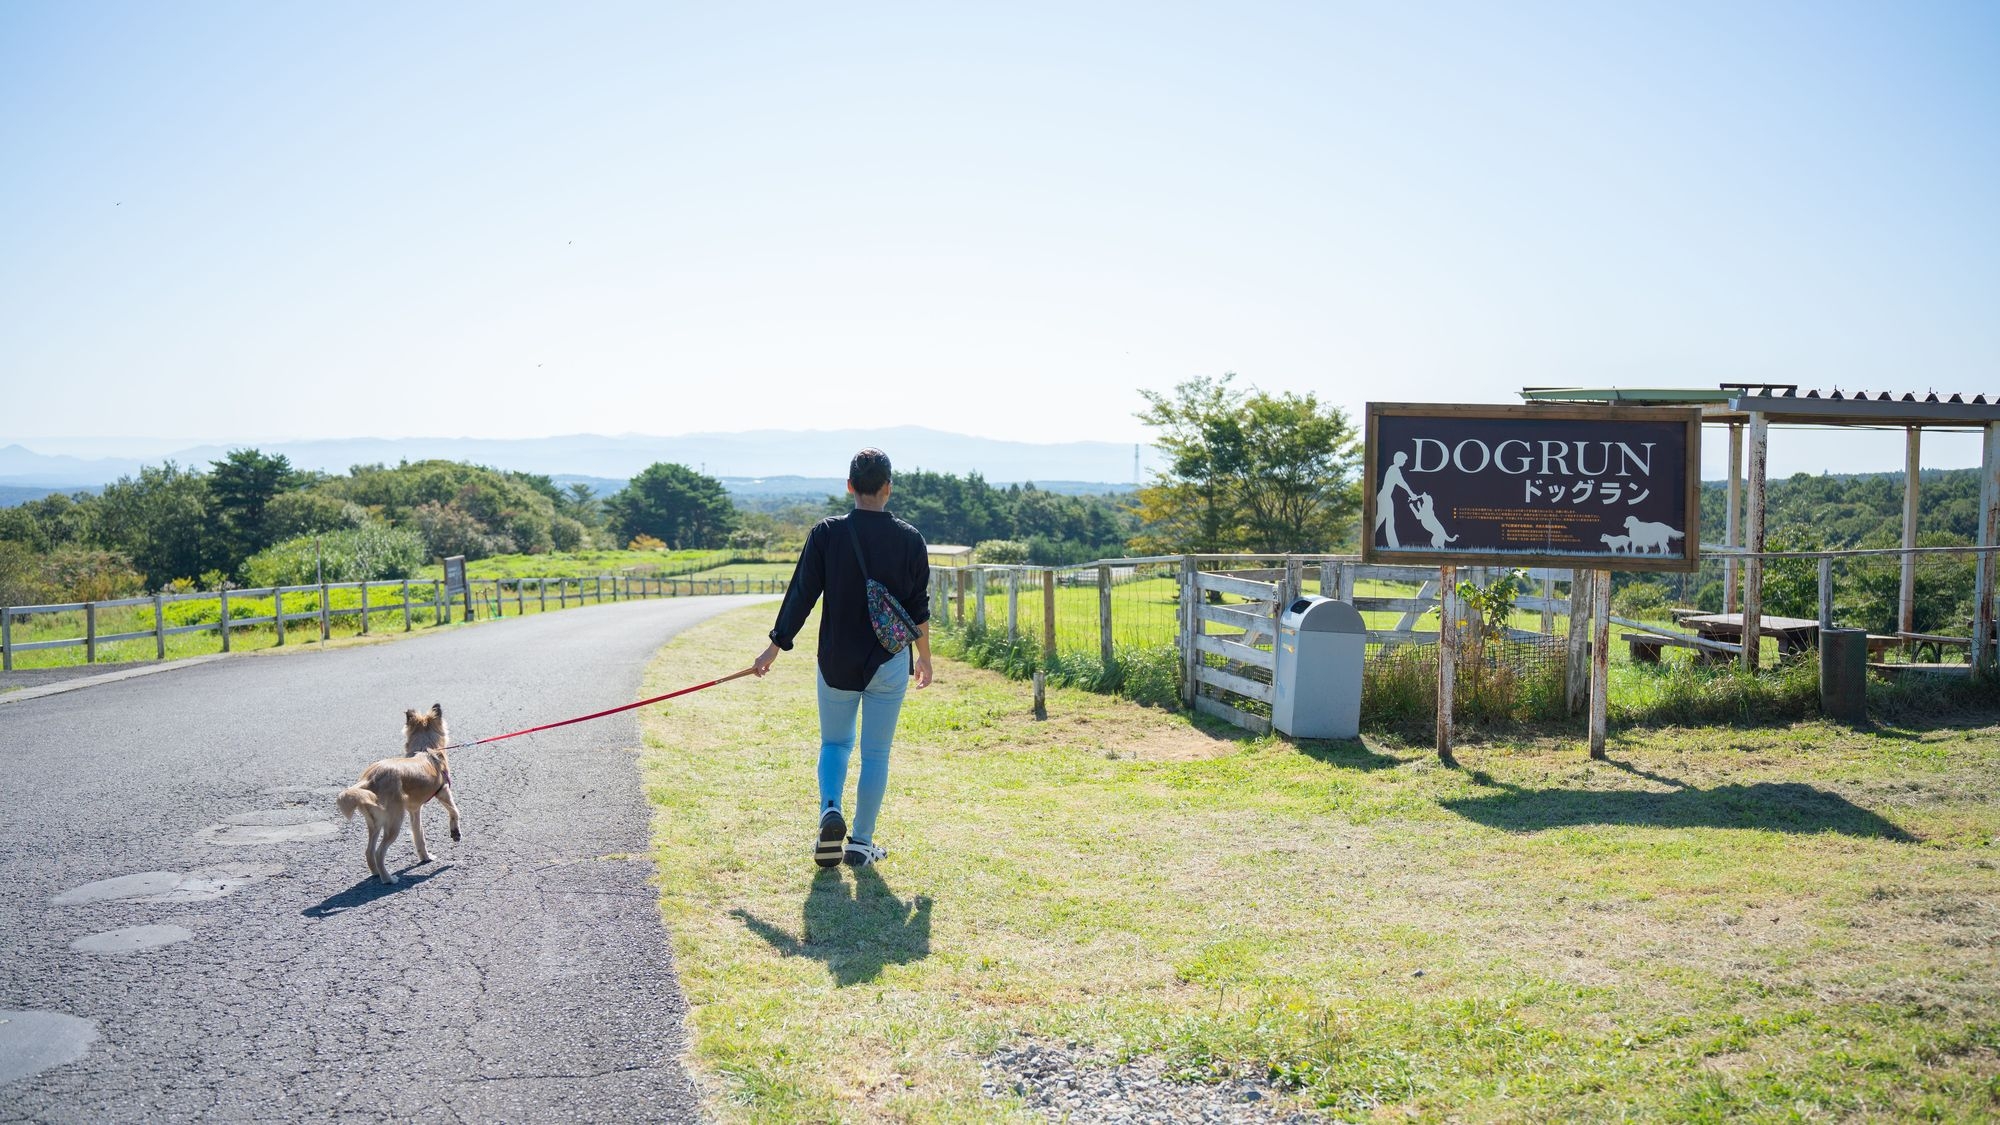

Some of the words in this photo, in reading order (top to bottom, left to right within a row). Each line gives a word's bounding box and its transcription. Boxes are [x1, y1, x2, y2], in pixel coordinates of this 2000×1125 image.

[1409, 438, 1656, 476] DOGRUN
[1525, 479, 1650, 505] ドッグラン
